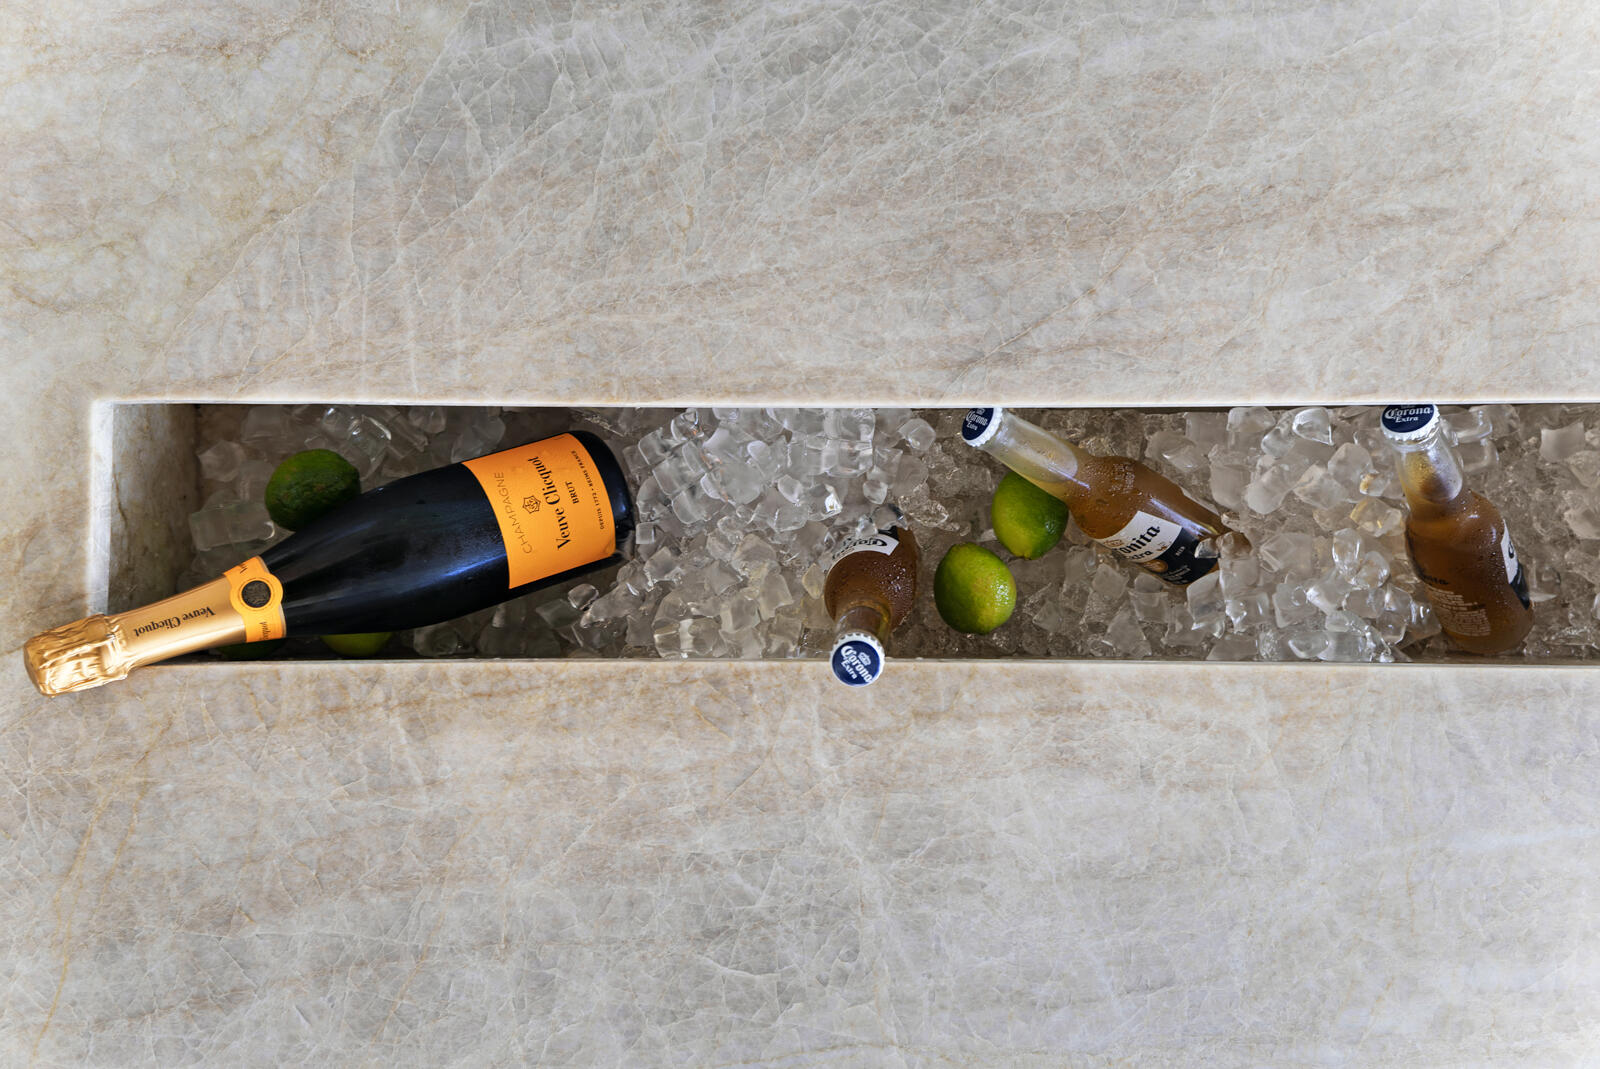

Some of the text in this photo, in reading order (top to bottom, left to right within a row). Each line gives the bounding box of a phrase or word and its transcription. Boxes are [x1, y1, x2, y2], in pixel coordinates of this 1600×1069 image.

[966, 410, 988, 426] Corona
[1384, 407, 1431, 419] Corona
[527, 456, 573, 550] Veuve Clicquot
[565, 481, 580, 504] BRUT
[494, 471, 533, 554] CHAMPAGNE
[1118, 526, 1161, 553] onita
[133, 606, 216, 637] Veuve Clicquot
[841, 645, 873, 683] Corona
[841, 659, 858, 680] Extra
